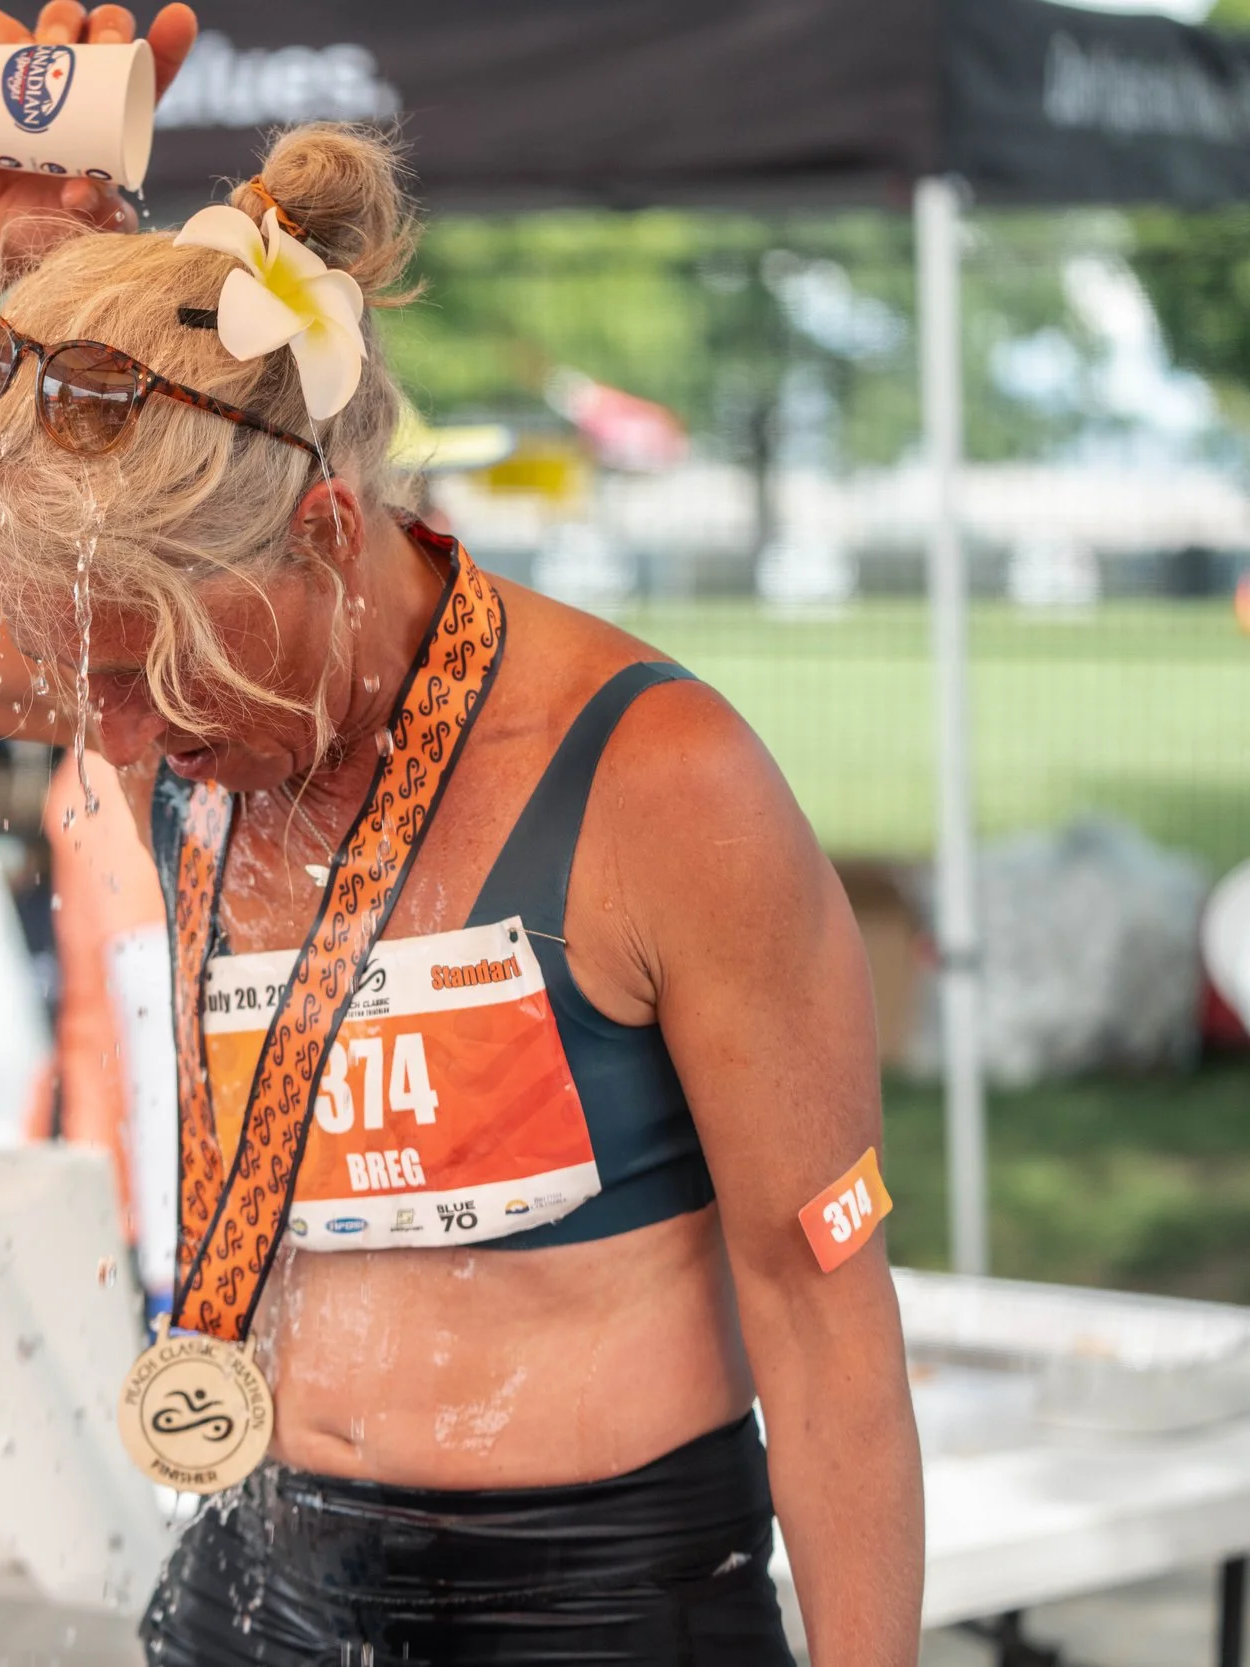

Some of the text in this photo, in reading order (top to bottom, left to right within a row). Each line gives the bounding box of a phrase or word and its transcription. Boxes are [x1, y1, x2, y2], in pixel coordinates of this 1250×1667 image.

[208, 989, 231, 1014] uly
[234, 986, 262, 1009] 20,
[314, 1032, 440, 1134] 374
[346, 1147, 427, 1192] BREG
[436, 1200, 476, 1214] BLUE
[822, 1177, 873, 1244] 374
[440, 1212, 479, 1233] 70
[150, 1459, 219, 1485] FINISHER
